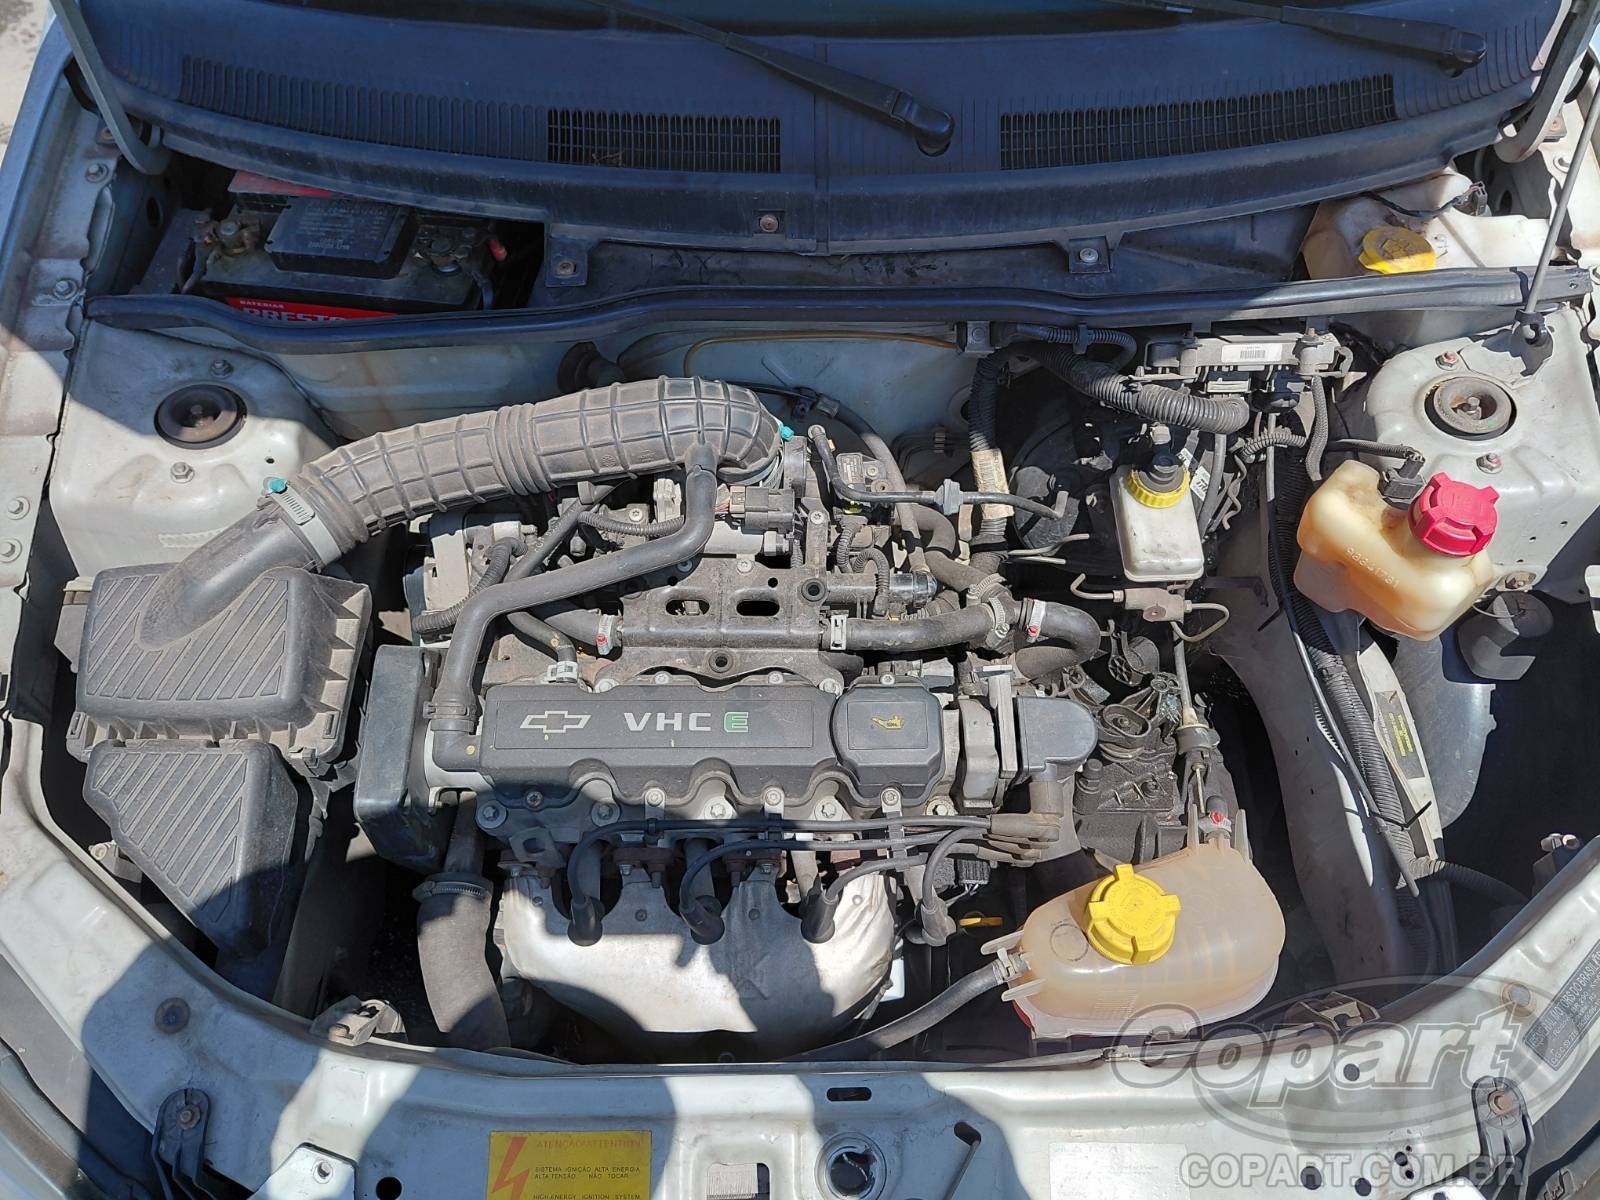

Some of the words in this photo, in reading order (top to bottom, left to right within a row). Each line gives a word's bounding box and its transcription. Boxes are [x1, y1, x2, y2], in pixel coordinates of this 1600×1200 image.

[623, 712, 712, 732] VHC
[723, 711, 749, 733] E
[1575, 960, 1598, 986] BRASIL
[1569, 980, 1583, 995] DO
